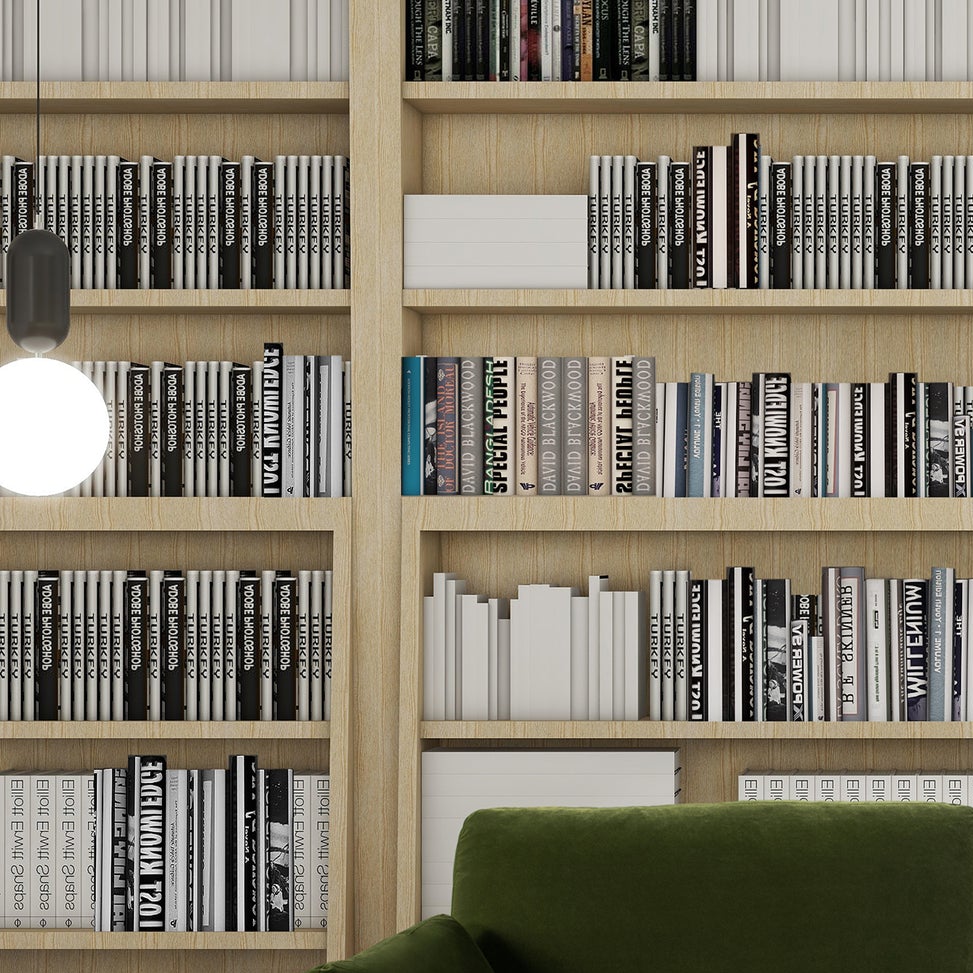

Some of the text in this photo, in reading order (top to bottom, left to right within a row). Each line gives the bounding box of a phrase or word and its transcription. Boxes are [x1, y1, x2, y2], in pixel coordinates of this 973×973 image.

[427, 26, 438, 59] CAPA
[634, 25, 645, 59] CAPA
[446, 422, 454, 470] DOCTOR
[461, 360, 476, 493] DAVID BLACKWOOD
[492, 360, 508, 494] SPECIAL PEOPLE
[542, 359, 556, 492] DAVID BLACKWOOD
